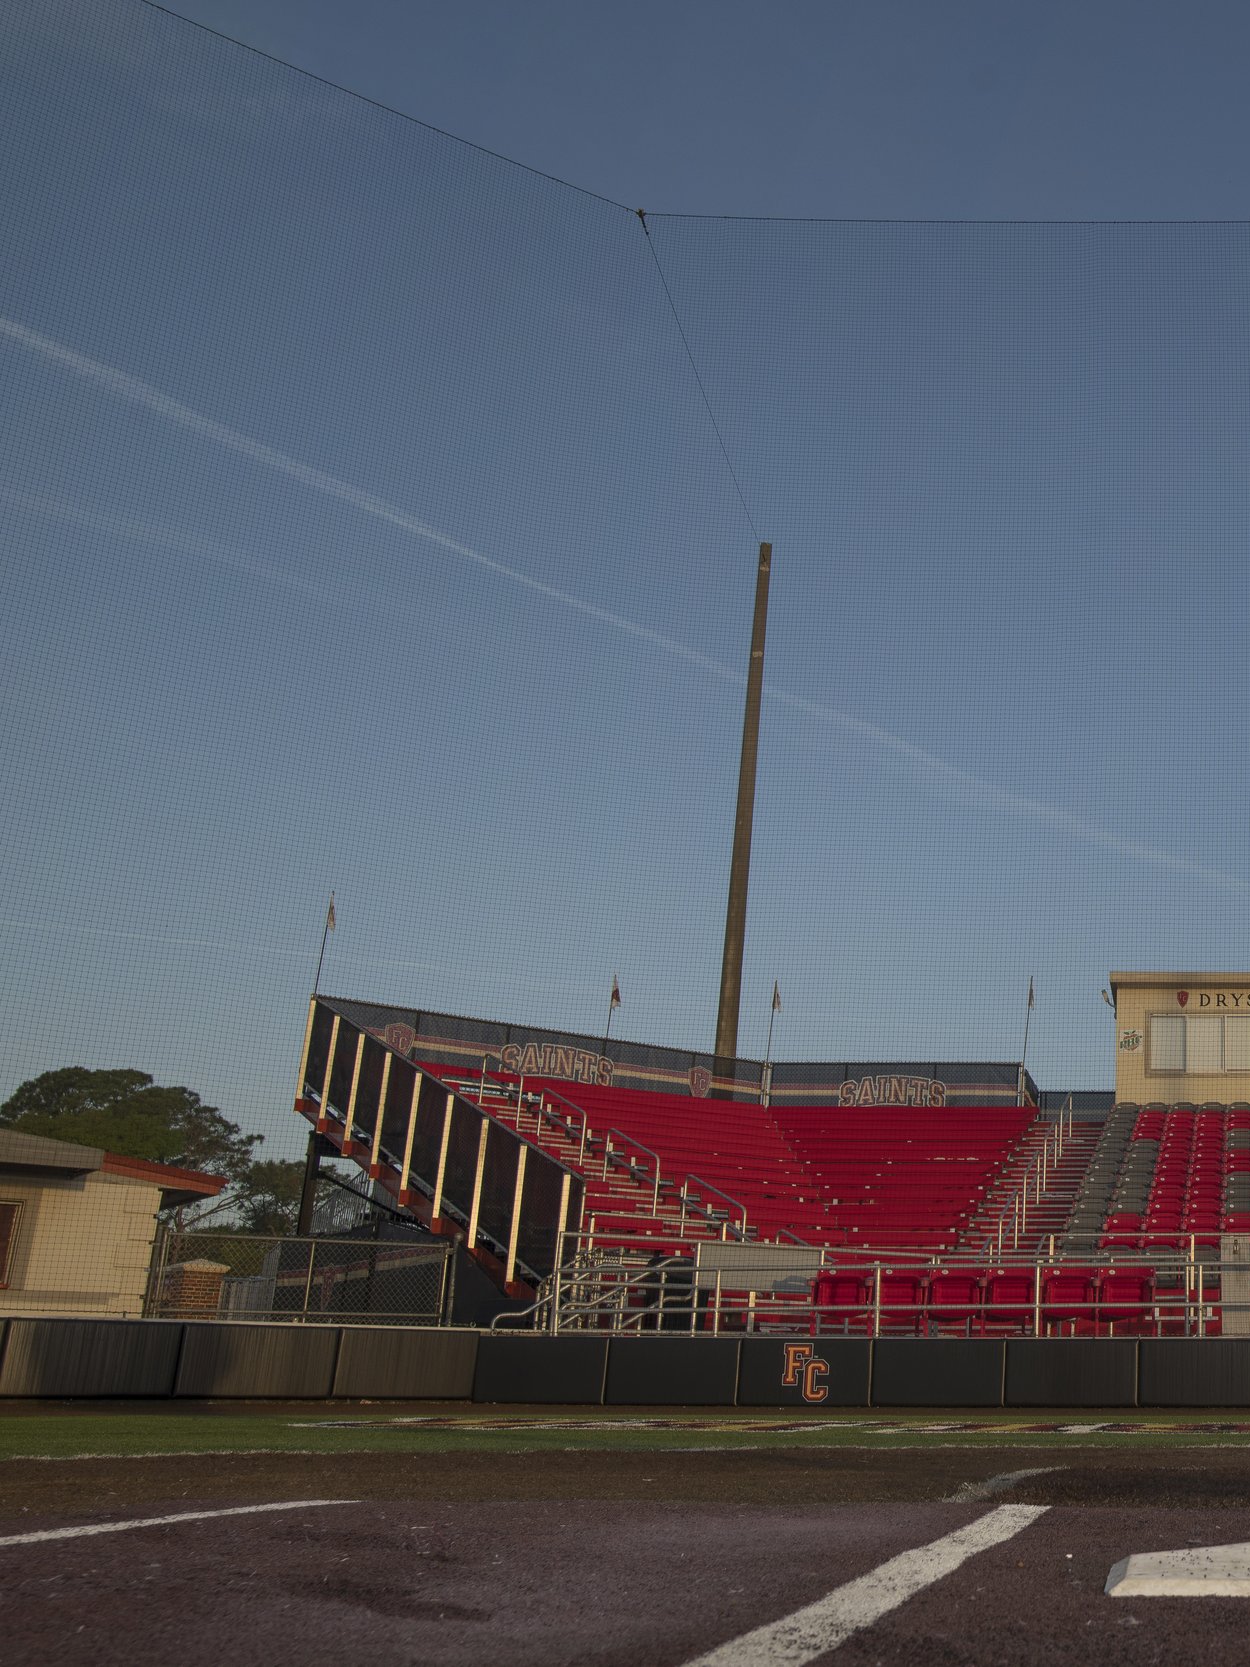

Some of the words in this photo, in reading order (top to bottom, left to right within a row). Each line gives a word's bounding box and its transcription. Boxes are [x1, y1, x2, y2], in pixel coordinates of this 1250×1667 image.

[500, 1043, 614, 1087] SAINTS
[838, 1075, 946, 1107] SAINTS
[782, 1342, 830, 1402] FC
